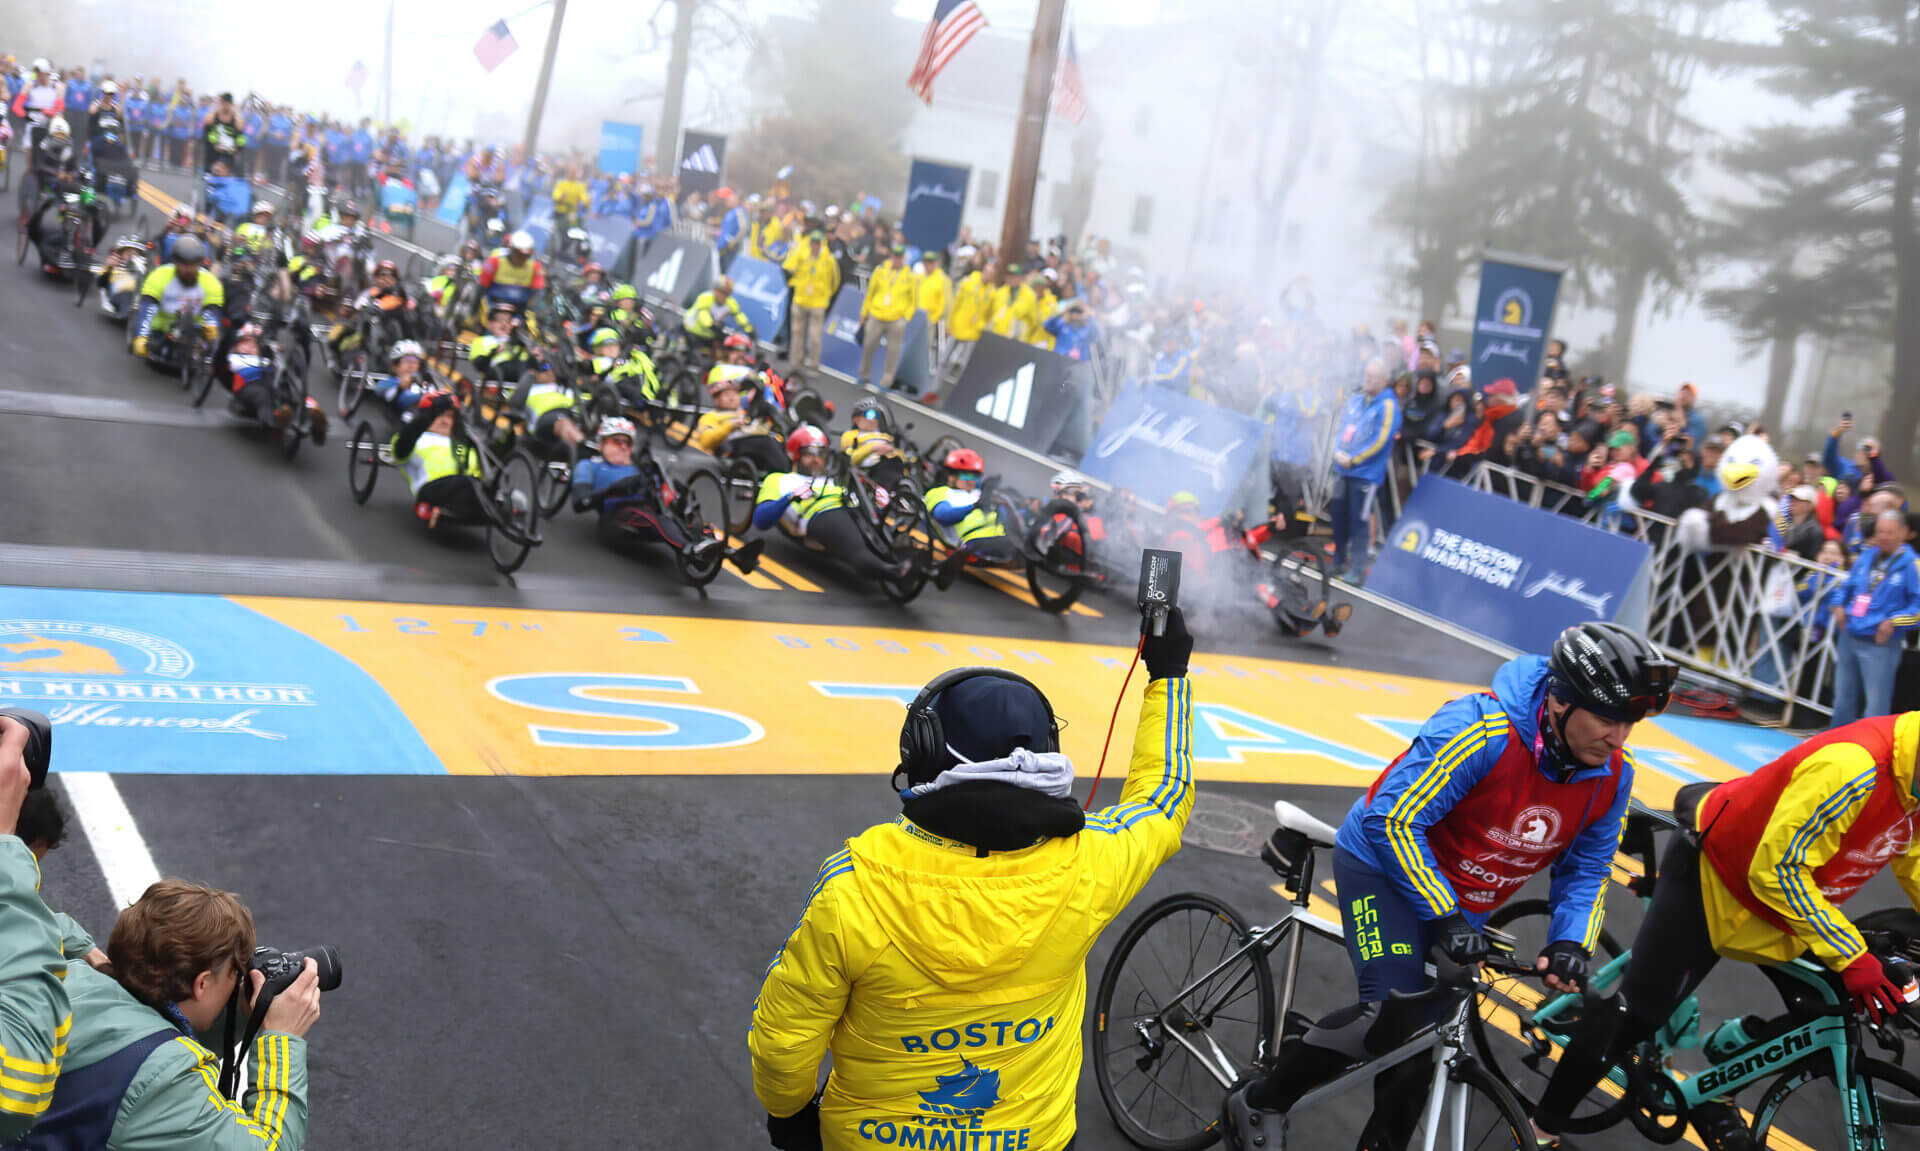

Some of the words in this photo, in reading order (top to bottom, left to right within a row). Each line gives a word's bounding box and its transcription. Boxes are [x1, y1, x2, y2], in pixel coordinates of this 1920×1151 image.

[1422, 545, 1517, 590] MARATHON
[1432, 528, 1462, 549] THE
[1459, 538, 1523, 574] BOSTON
[771, 634, 1056, 666] BOSTON
[44, 683, 314, 702] MARATHON
[50, 701, 288, 741] Hancock
[1363, 894, 1378, 925] LC
[1352, 898, 1370, 961] SHOP
[1367, 926, 1385, 958] TRI
[1697, 1026, 1813, 1094] Bianchi
[858, 1119, 1031, 1151] COMMITTEE
